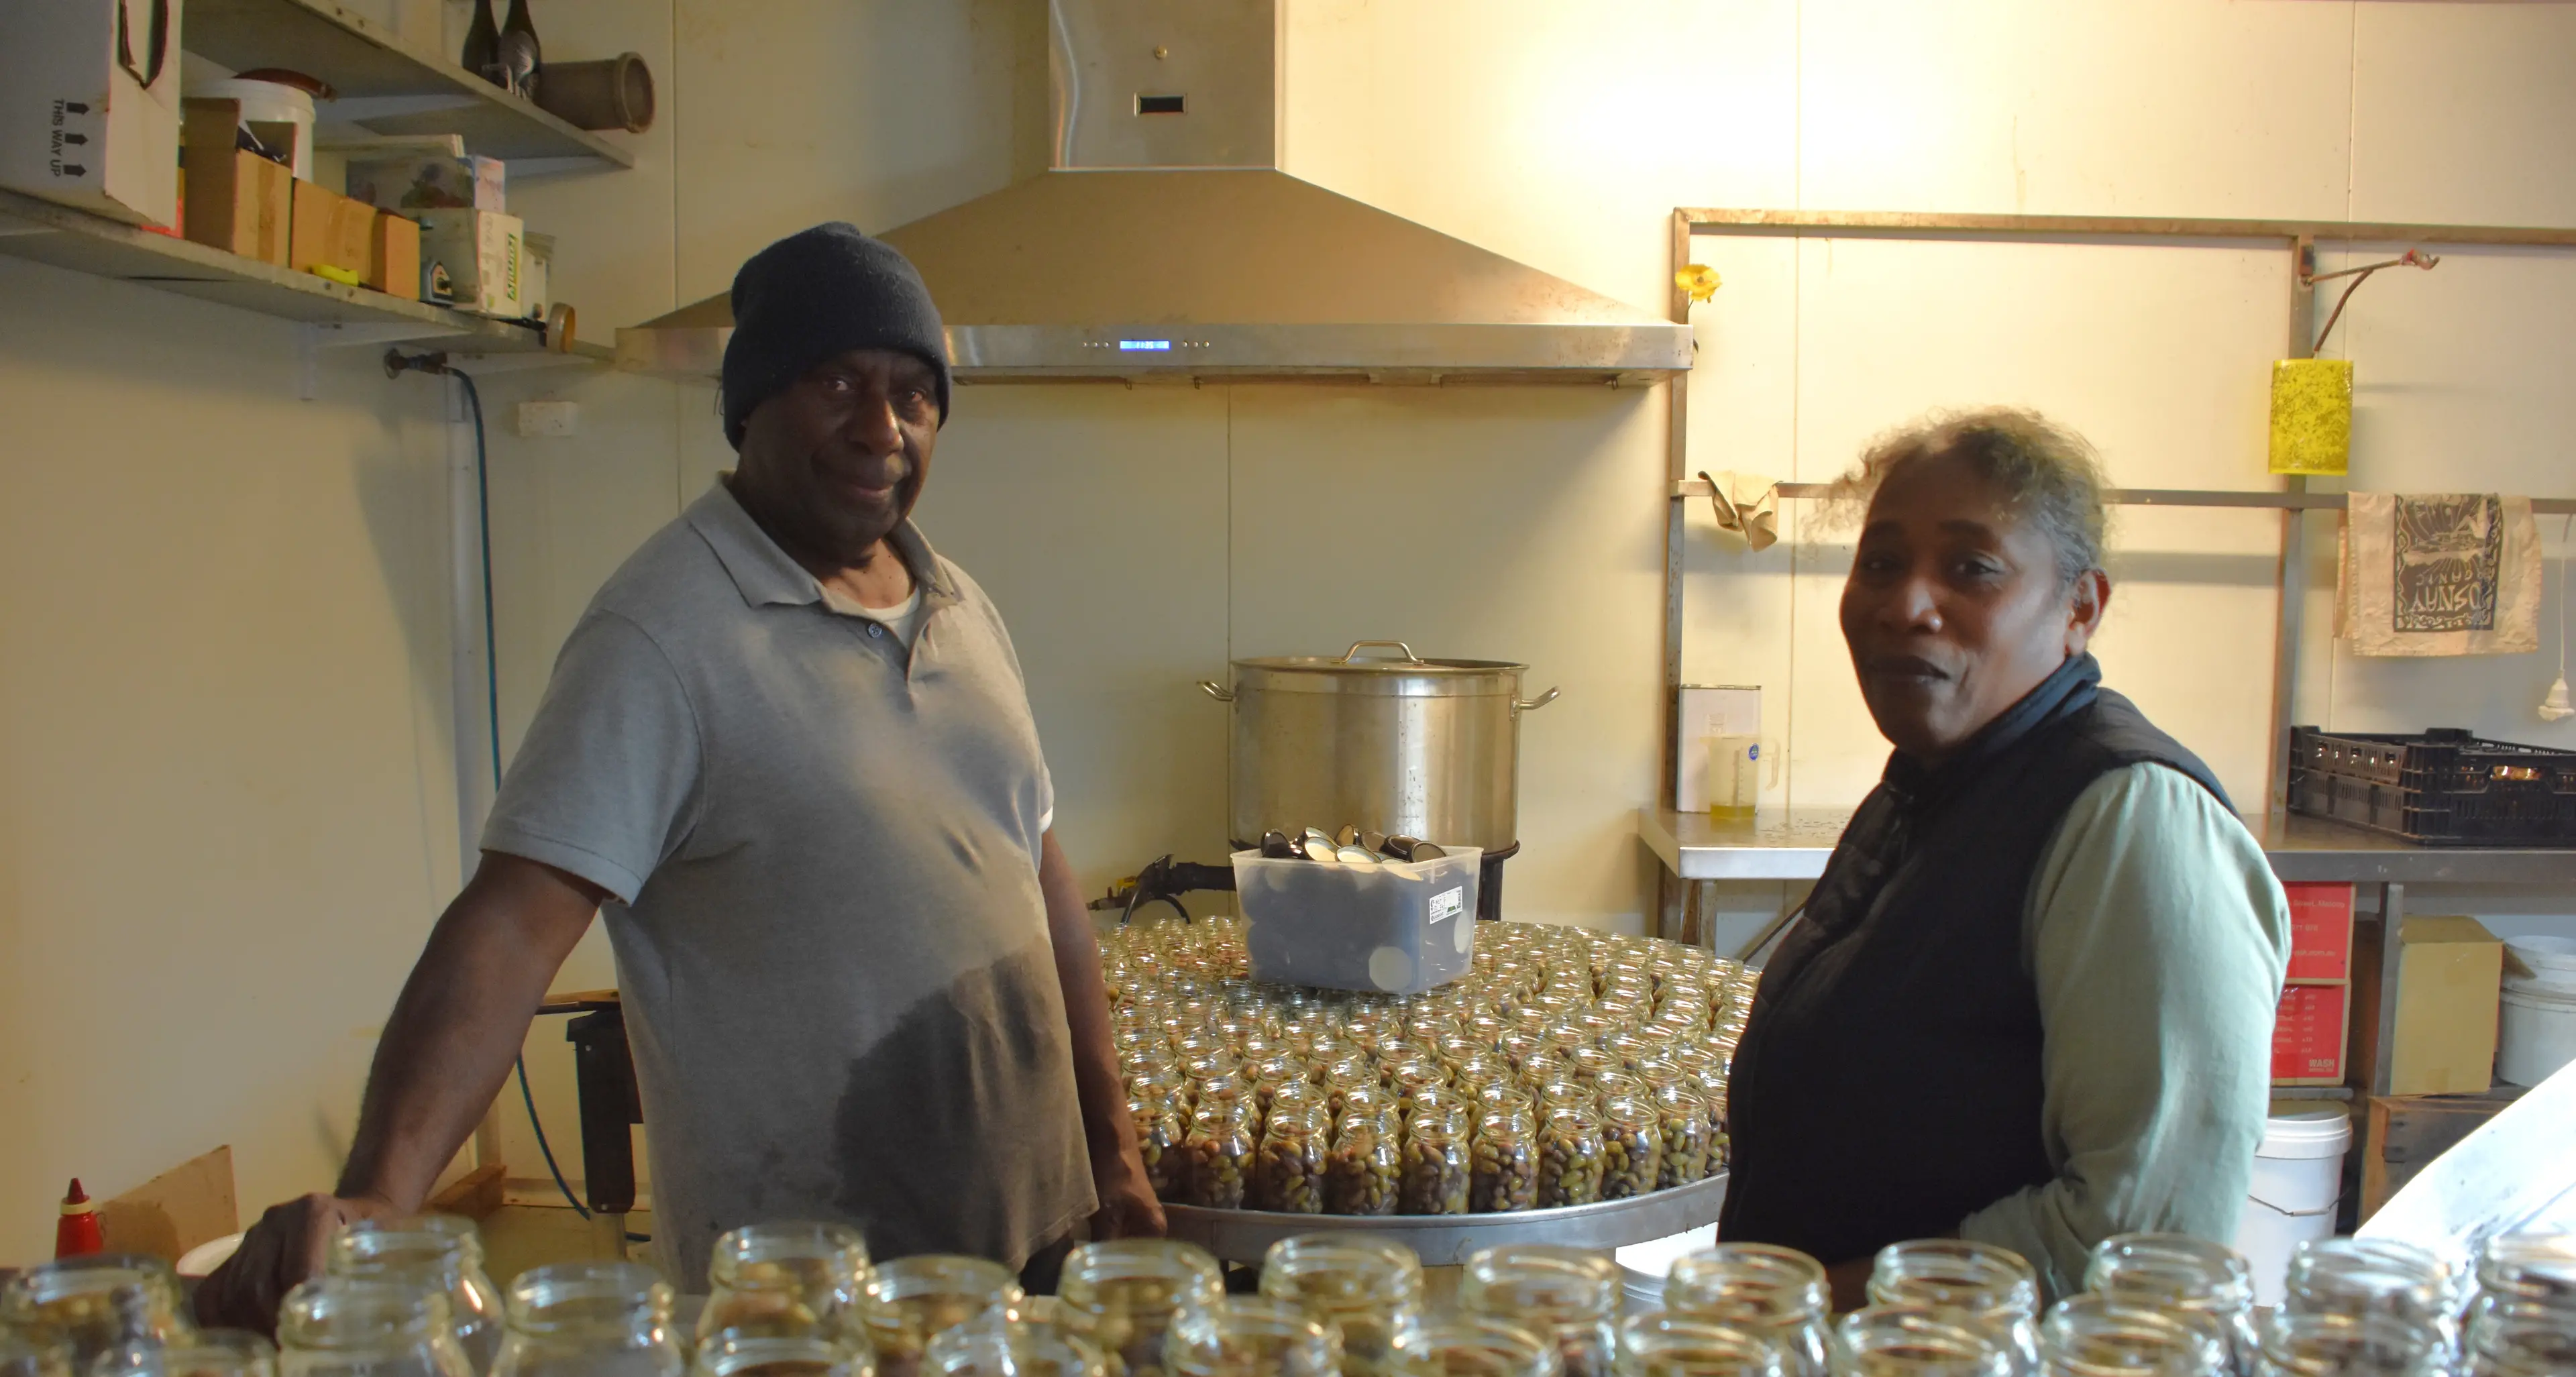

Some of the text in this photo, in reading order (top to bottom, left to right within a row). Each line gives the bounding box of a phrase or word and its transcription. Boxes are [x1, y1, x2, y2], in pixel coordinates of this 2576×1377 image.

[50, 98, 64, 177] THIS WAY UP
[2308, 1058, 2334, 1068] WASH
